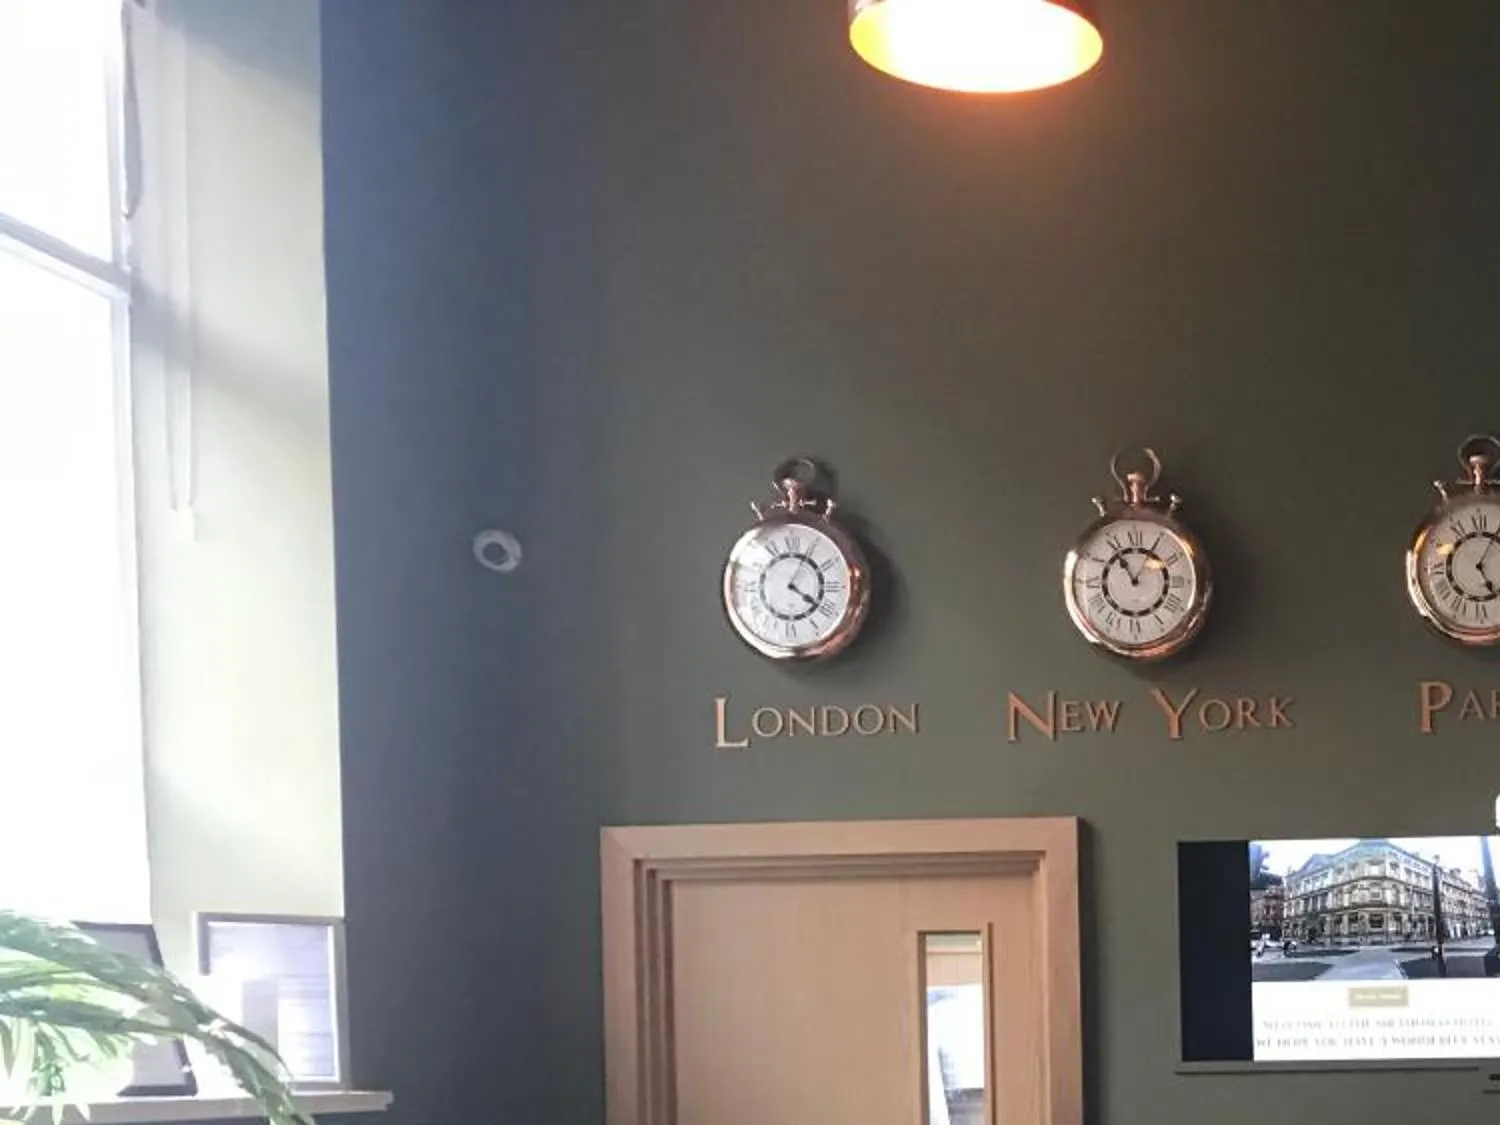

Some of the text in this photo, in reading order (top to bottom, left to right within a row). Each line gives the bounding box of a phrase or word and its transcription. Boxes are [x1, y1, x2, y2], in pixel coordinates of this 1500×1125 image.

[714, 697, 919, 748] LONDON
[1008, 687, 1294, 742] NEW YORK
